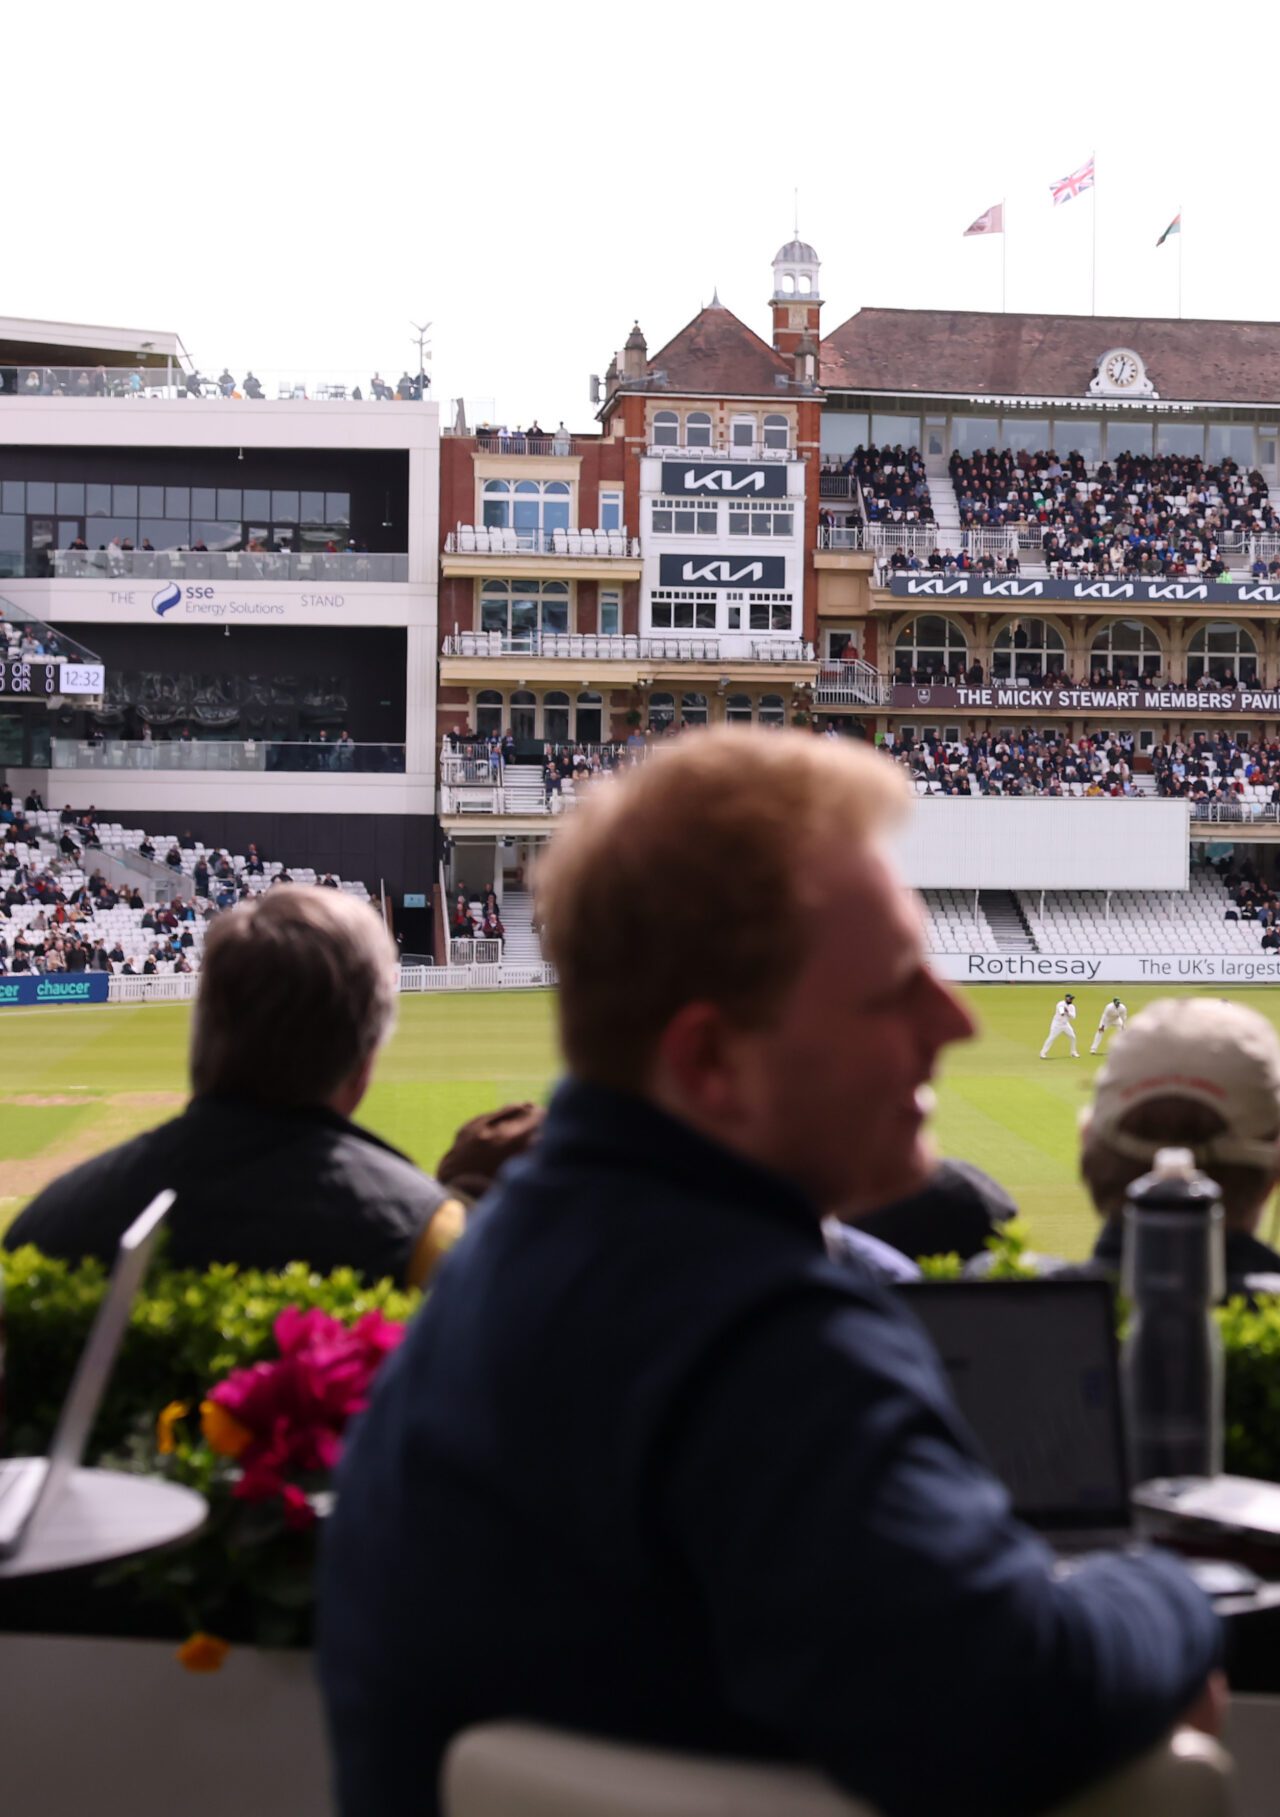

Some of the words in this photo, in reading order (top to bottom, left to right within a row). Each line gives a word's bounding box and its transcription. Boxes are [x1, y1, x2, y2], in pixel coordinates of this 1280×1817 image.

[684, 469, 765, 491] KIA
[682, 561, 763, 582] KIA
[109, 592, 136, 604] THE
[186, 587, 215, 599] sse
[300, 595, 345, 607] STAND
[186, 602, 226, 616] Energy
[229, 602, 284, 614] Solutions
[65, 671, 100, 687] 12:32
[957, 689, 992, 705] THE
[999, 690, 1052, 706] MICKY
[1058, 691, 1139, 707] STEWART
[969, 955, 1101, 979] Rothesay
[1139, 959, 1172, 975] The
[37, 979, 90, 995] chaucer
